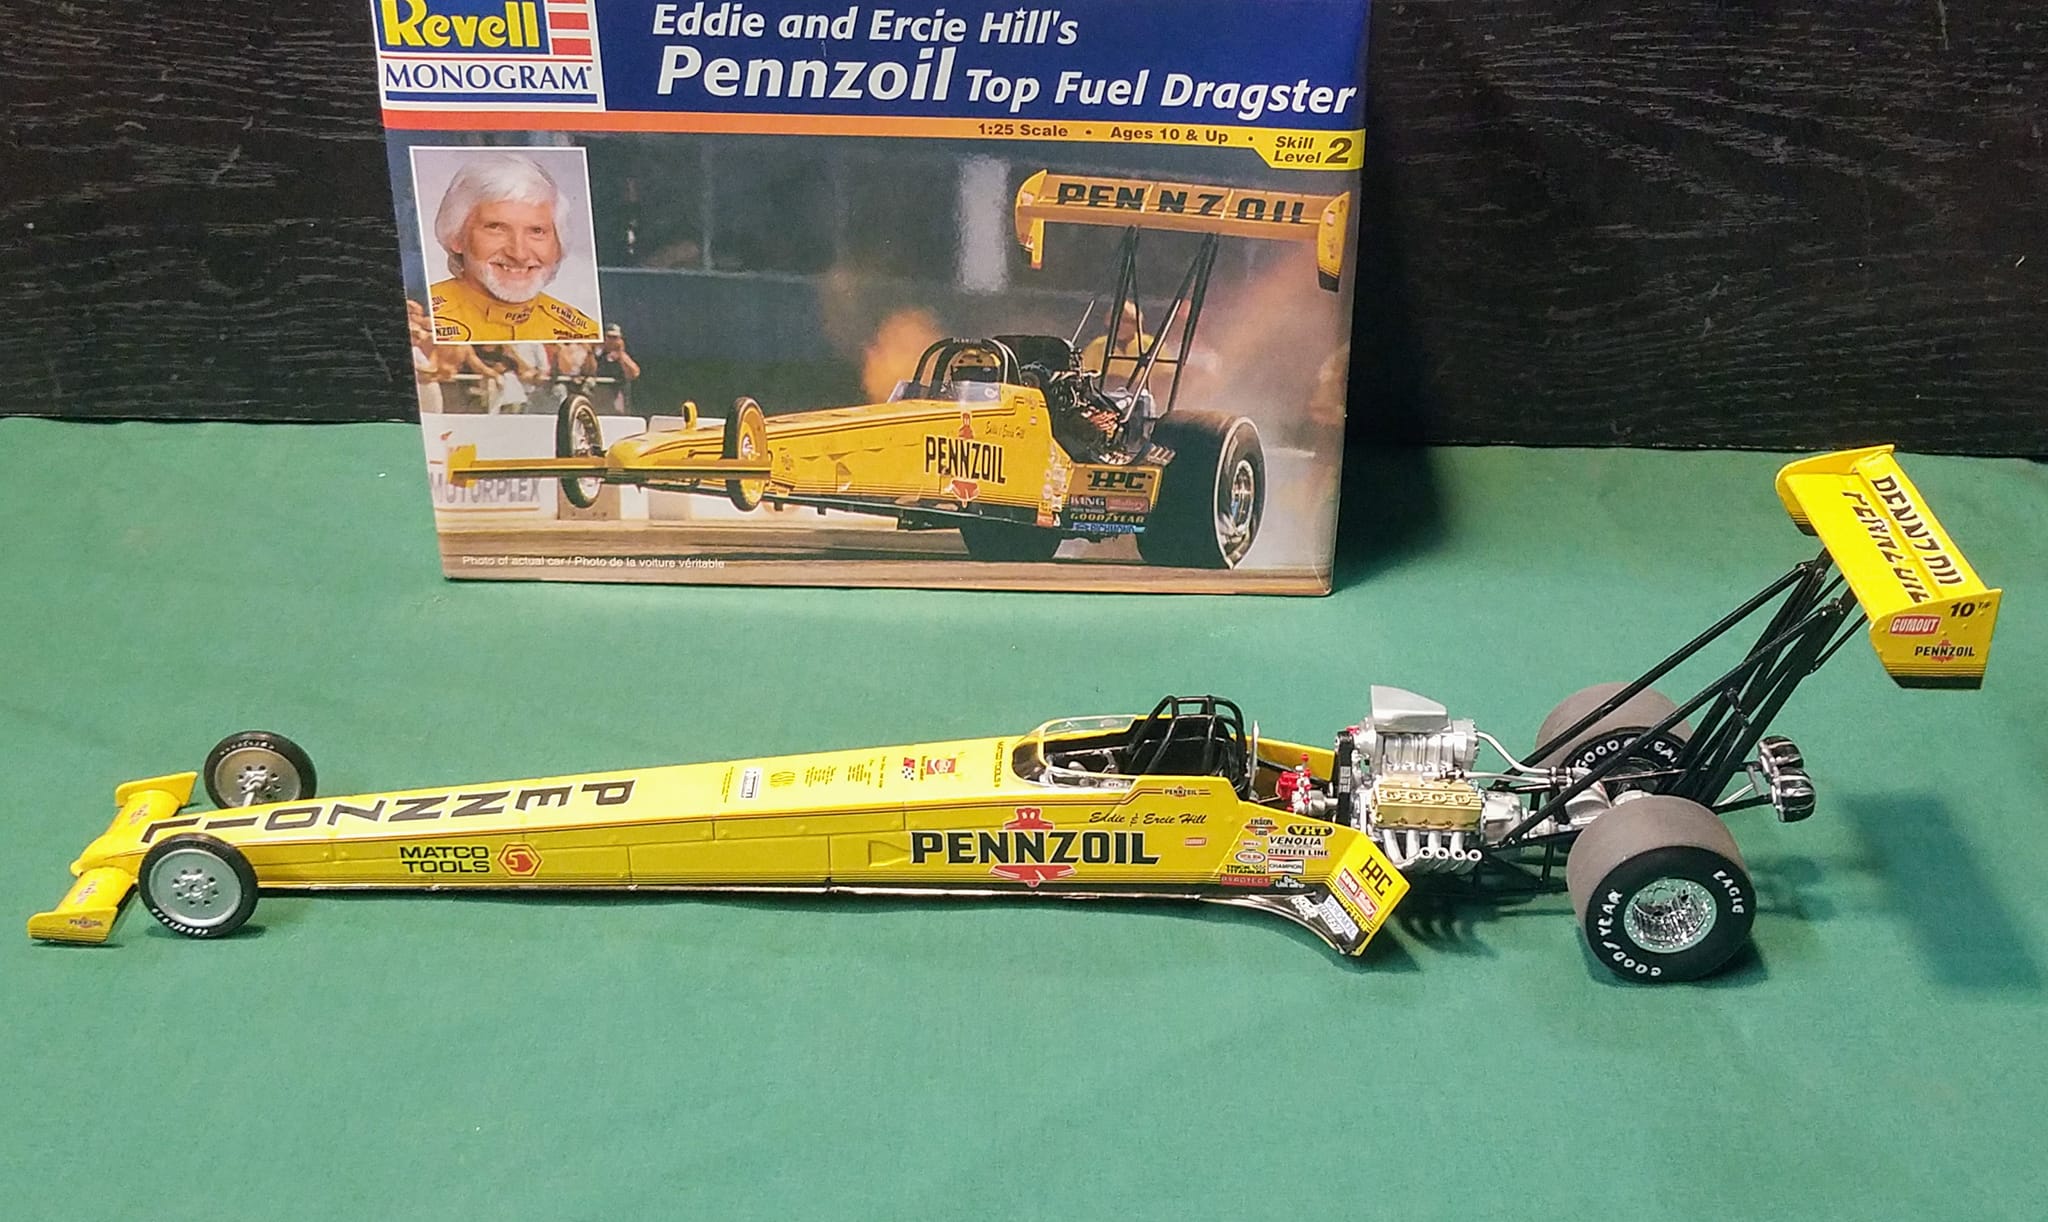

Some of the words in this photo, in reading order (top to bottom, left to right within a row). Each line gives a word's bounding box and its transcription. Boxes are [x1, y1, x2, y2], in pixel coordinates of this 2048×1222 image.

[381, 0, 540, 47] Revell
[652, 2, 765, 38] Eddie
[778, 6, 859, 40] and
[869, 8, 967, 43] Ercie
[979, 8, 1079, 45] Hill's
[385, 63, 589, 90] MONOGRAM
[657, 45, 957, 101] Pennzoil
[966, 69, 1040, 113] Top
[1054, 69, 1150, 106] Fuel
[1159, 73, 1357, 121] Dragster
[977, 123, 1014, 136] 1:25
[1020, 124, 1068, 138] Scale
[1110, 126, 1153, 142] Ages
[1159, 128, 1180, 141] 10
[1186, 129, 1198, 142] &
[1205, 130, 1229, 145] Up
[1275, 135, 1314, 150] Skill
[1273, 149, 1321, 164] Level
[1325, 137, 1353, 164] 2
[925, 436, 1006, 484] PENNZOIL
[462, 555, 495, 566] Photo
[497, 556, 510, 566] of
[511, 556, 545, 567] actual
[547, 558, 565, 567] car
[574, 557, 607, 568] Photo
[608, 557, 624, 568] de
[626, 558, 637, 568] la
[639, 558, 676, 569] voiture
[679, 558, 725, 569] véritable
[1951, 602, 1976, 617] 10
[1891, 616, 1938, 632] GUMOUT
[1914, 645, 1976, 657] PENNZOIL
[1089, 811, 1125, 824] Eddie
[1143, 813, 1175, 825] Ercie
[1179, 813, 1207, 825] Hill
[1292, 826, 1330, 836] VHT
[911, 831, 1161, 865] PENNZOIL
[1269, 836, 1322, 846] VENOLIA
[400, 846, 489, 859] MATCO
[1268, 848, 1305, 856] CENTER
[1306, 849, 1329, 857] LINE
[402, 860, 490, 873] TOOLS
[1269, 862, 1303, 870] CHAMPION
[1359, 855, 1392, 897] HPC
[1712, 870, 1745, 914] EAGLE
